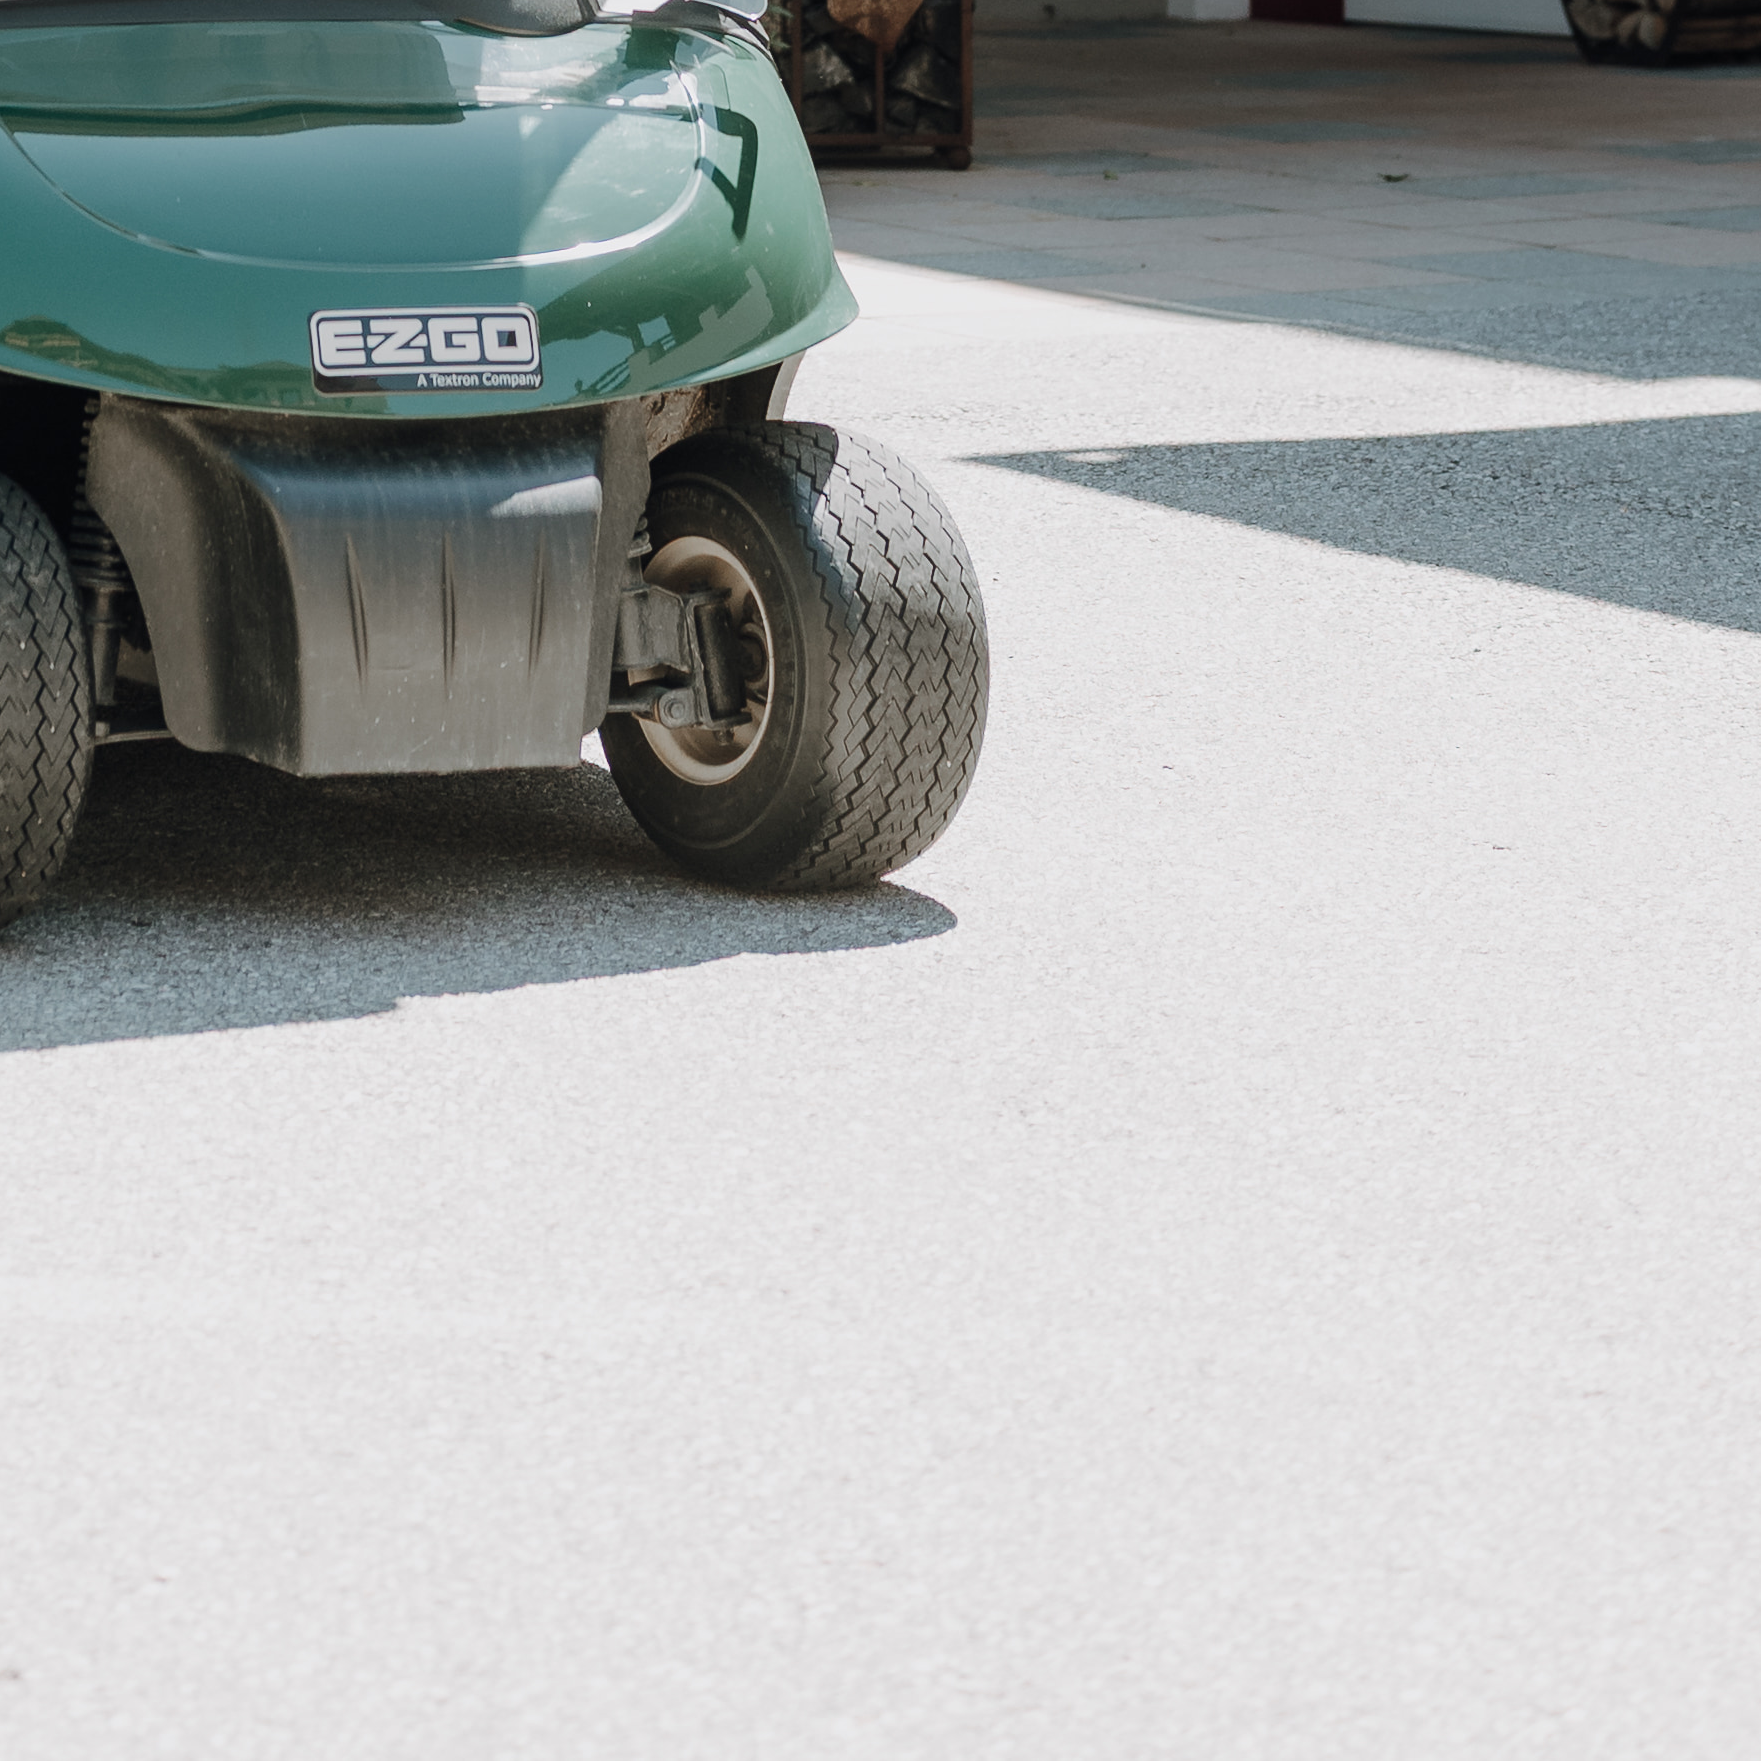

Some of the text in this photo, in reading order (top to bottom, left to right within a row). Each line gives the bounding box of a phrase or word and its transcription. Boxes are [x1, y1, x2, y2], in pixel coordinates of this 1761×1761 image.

[417, 372, 541, 388] A Textron Company
